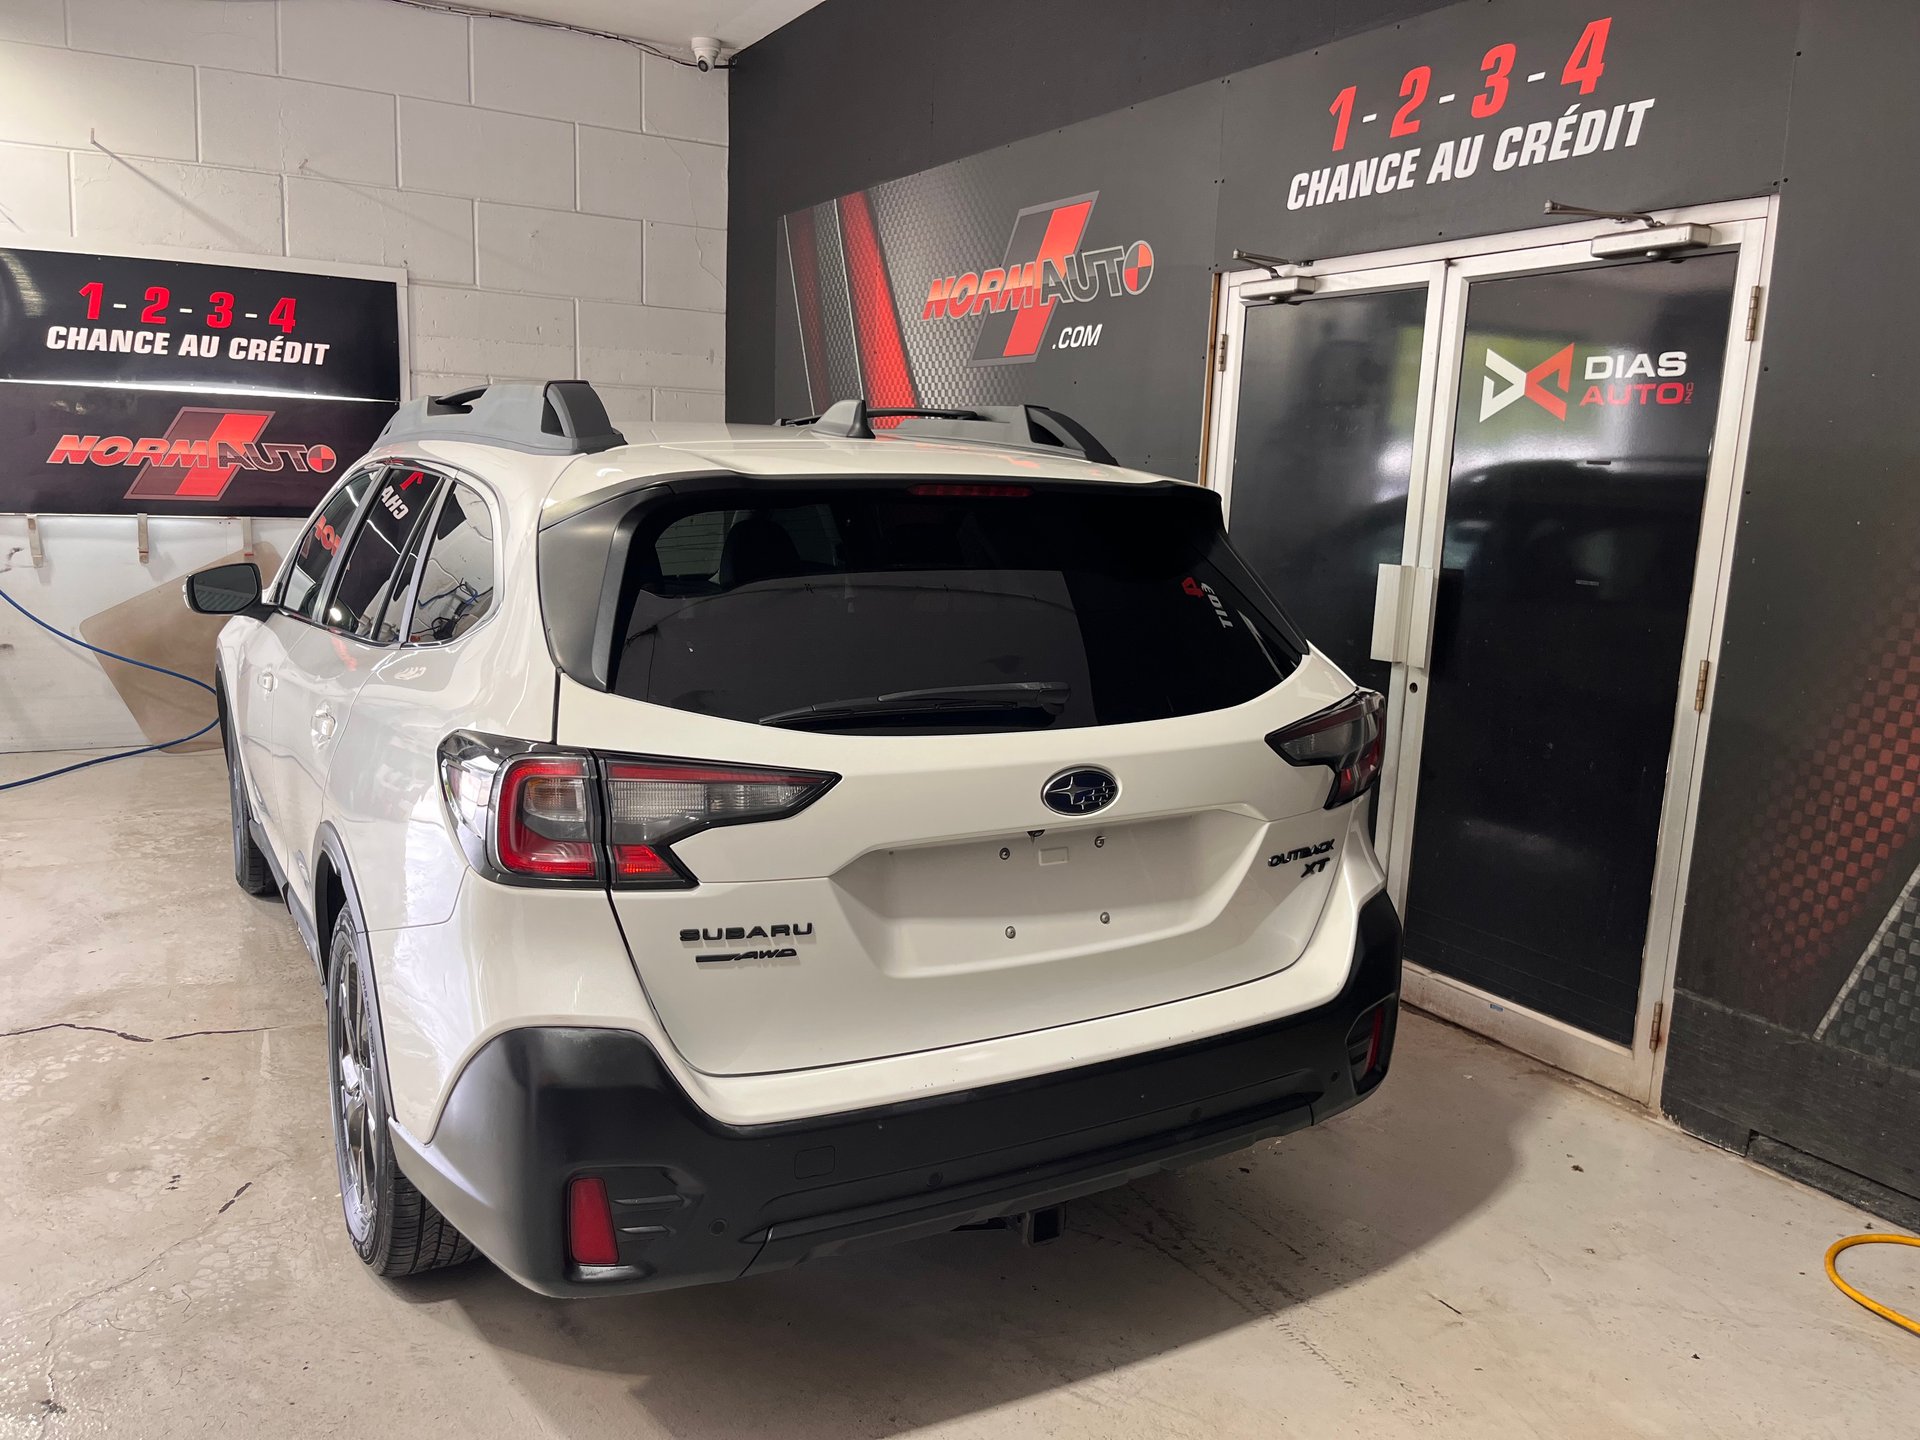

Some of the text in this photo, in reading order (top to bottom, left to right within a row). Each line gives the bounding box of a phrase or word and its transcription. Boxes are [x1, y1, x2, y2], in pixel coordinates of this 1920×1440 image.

[1286, 98, 1656, 211] CHANCE AU CRÉDIT
[921, 240, 1155, 322] NORMAUTO
[46, 325, 330, 366] CHANCE AU CRÉDIT
[1584, 351, 1688, 381] DIAS
[1579, 381, 1685, 407] AUTO
[46, 434, 337, 474] NORMAUTO
[1268, 838, 1335, 867] OUTBACK
[1300, 857, 1331, 878] XT
[679, 922, 813, 942] SUBARU
[733, 948, 798, 961] AWD
